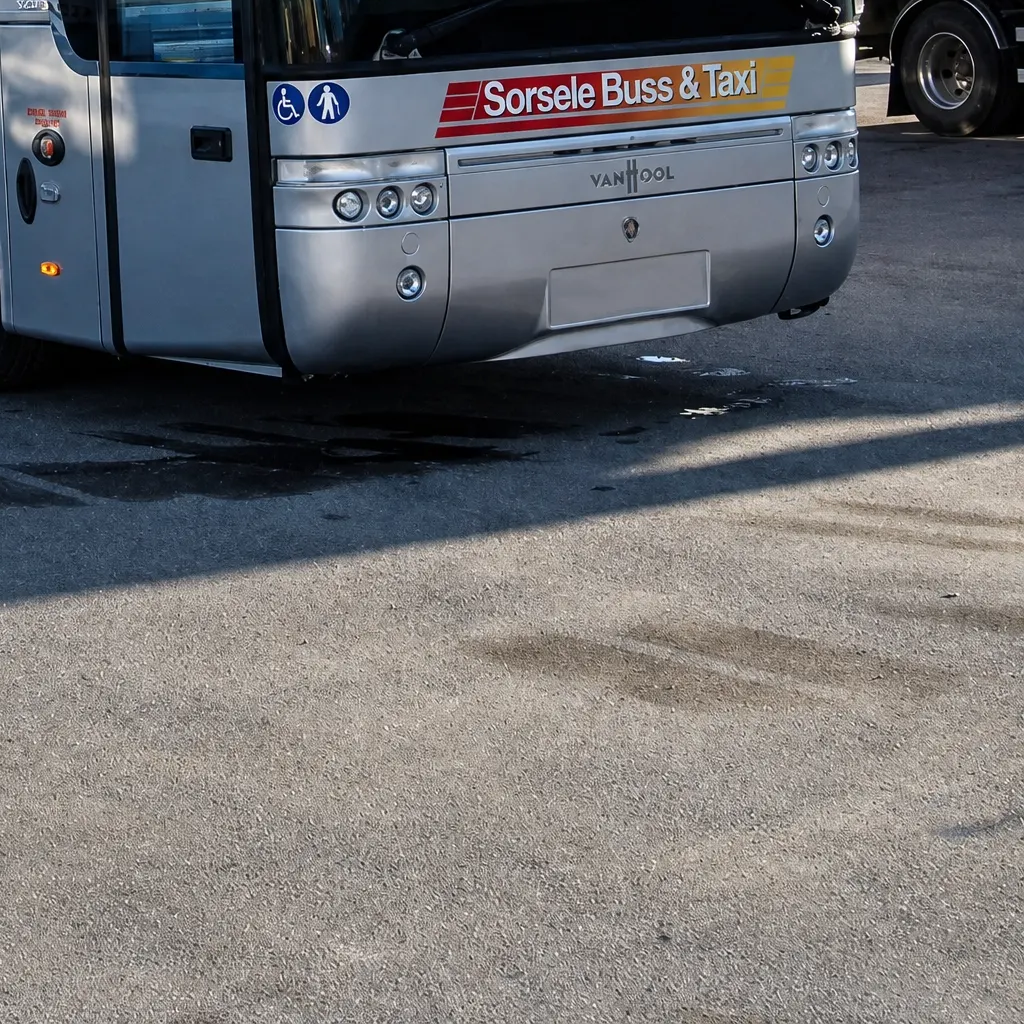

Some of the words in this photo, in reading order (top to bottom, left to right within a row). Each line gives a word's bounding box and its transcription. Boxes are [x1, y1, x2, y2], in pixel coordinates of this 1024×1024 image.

[483, 76, 596, 117] Sorsele
[601, 72, 675, 107] Buss
[679, 65, 702, 100] &
[702, 60, 758, 97] Taxi
